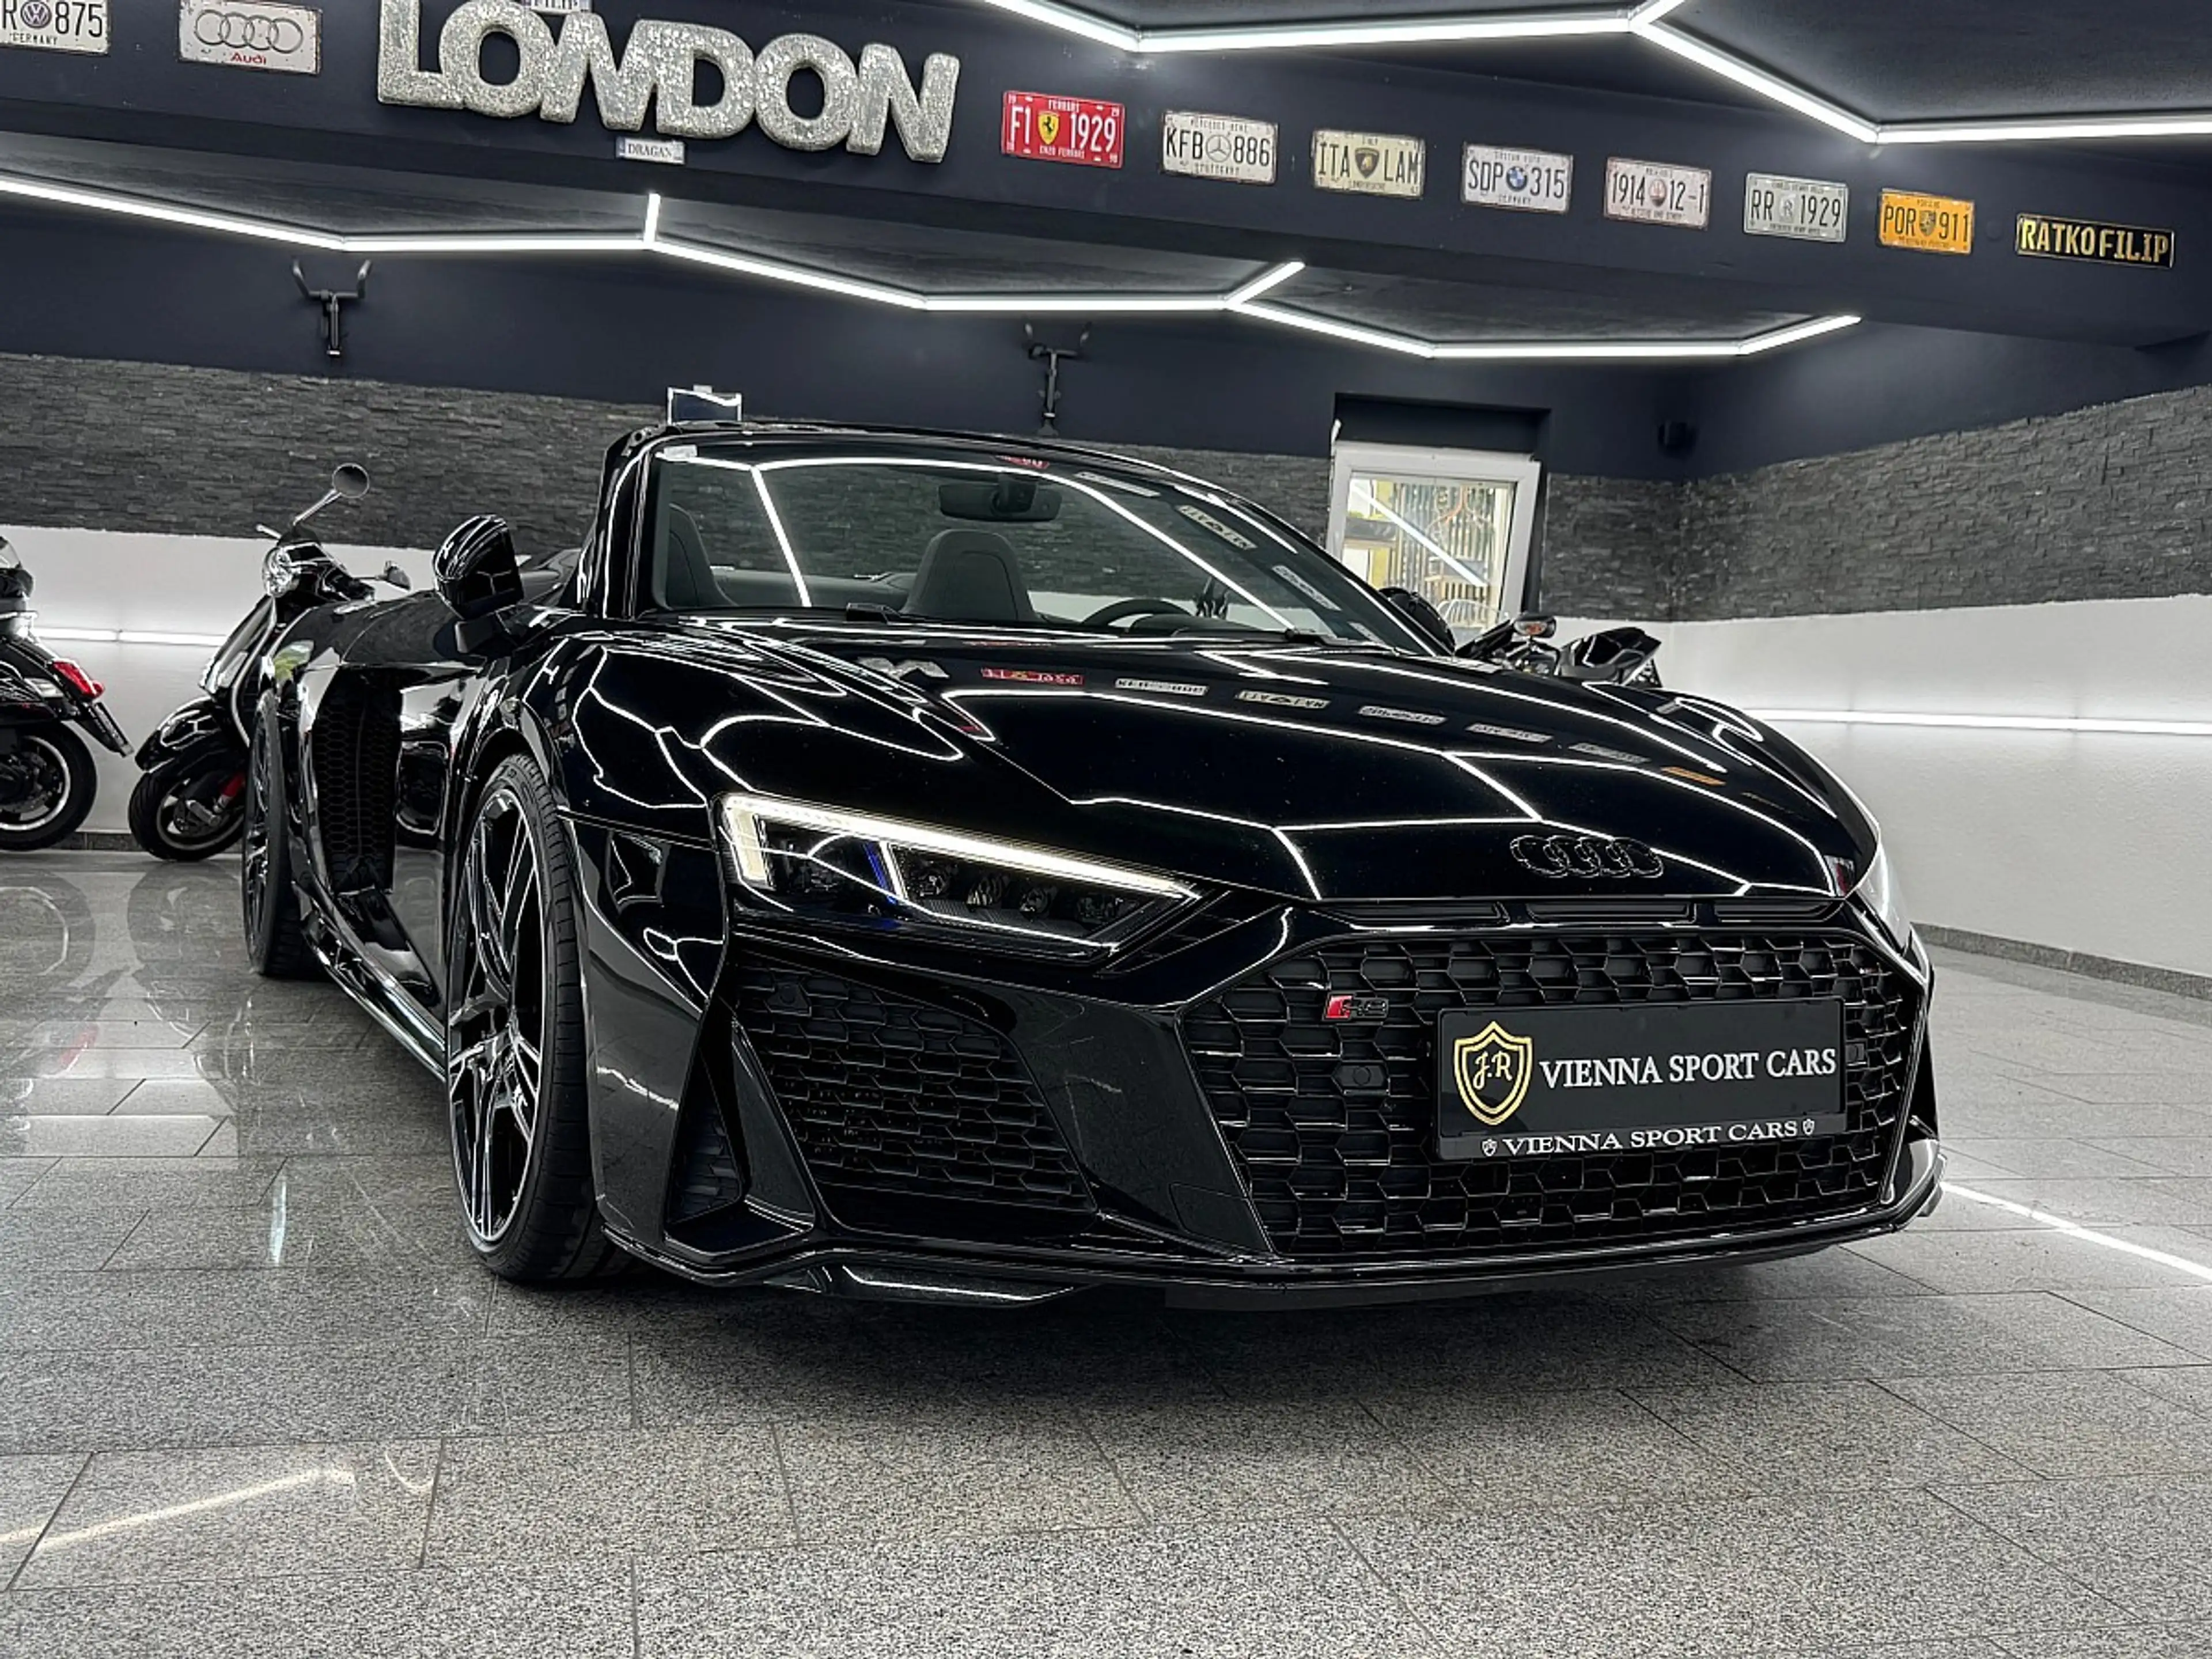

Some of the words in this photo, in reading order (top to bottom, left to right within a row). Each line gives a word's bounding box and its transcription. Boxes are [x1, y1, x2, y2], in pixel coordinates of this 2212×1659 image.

[55, 1, 103, 38] 875
[230, 52, 267, 65] Audi
[377, 0, 961, 163] LONDON
[1047, 99, 1080, 113] FERRARI
[1011, 106, 1032, 145] F1
[1070, 112, 1116, 153] 1929
[1166, 127, 1204, 160] KFB
[1233, 135, 1271, 167] 886
[628, 143, 672, 158] DRAGAN
[1318, 141, 1351, 178] ITA
[1384, 149, 1419, 185] LAM
[1468, 159, 1504, 192] SDP
[1529, 166, 1566, 199] 315
[1612, 171, 1646, 207] 1914
[1751, 189, 1774, 221] RR
[1800, 194, 1842, 228] 1929
[1883, 205, 1918, 237] POR
[1938, 211, 1970, 243] 911
[1538, 1055, 1664, 1089] VIENNA
[1668, 1052, 1760, 1082] SPORT
[1766, 1048, 1836, 1078] CARS
[1502, 1131, 1623, 1156] VIENNA
[1630, 1126, 1721, 1149] SPORT
[1728, 1120, 1798, 1142] CARS
